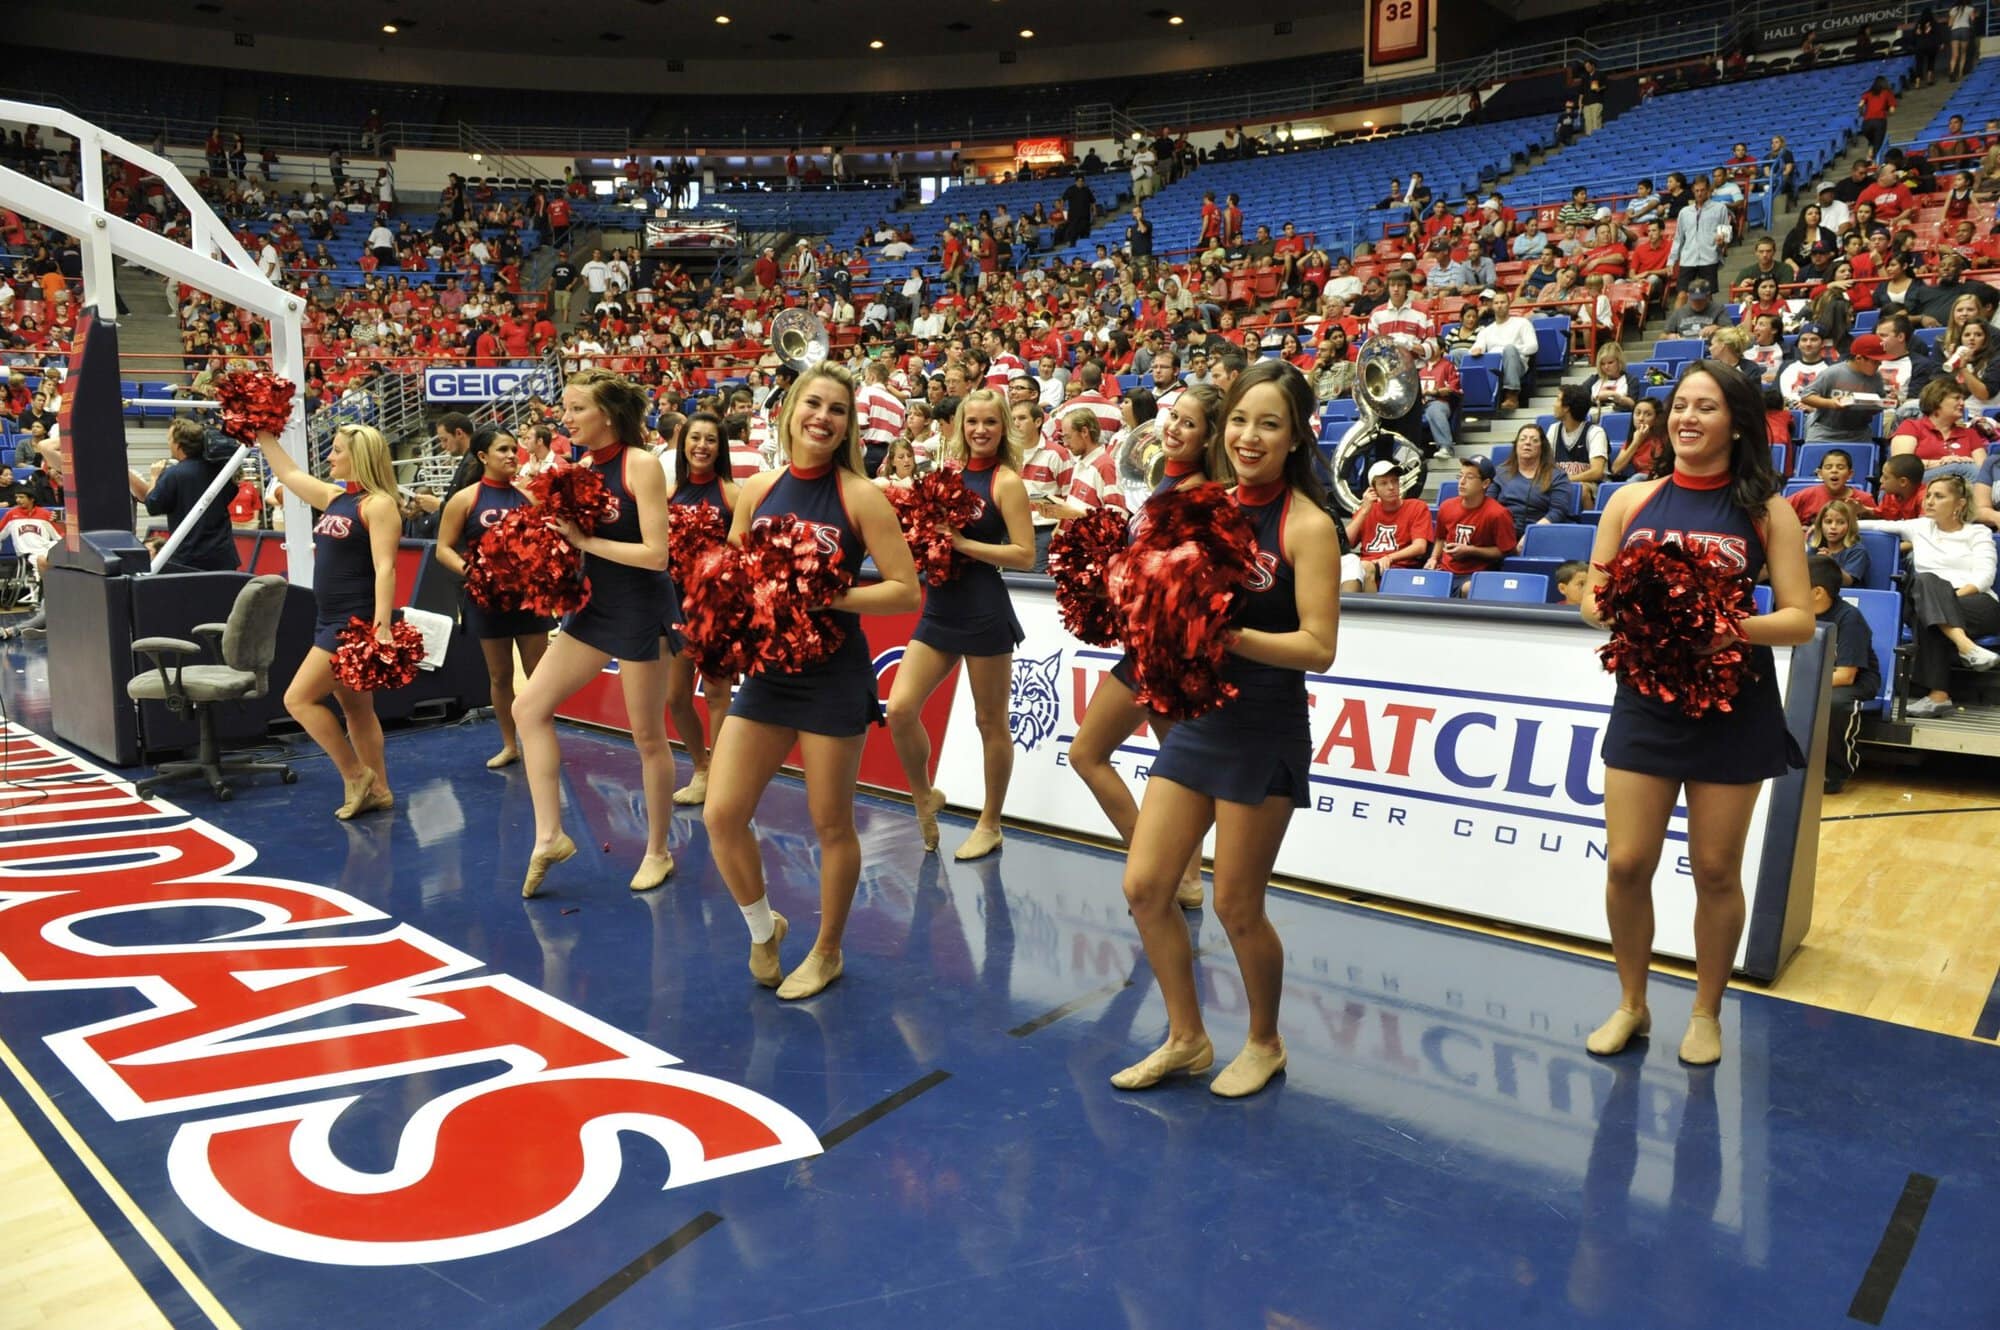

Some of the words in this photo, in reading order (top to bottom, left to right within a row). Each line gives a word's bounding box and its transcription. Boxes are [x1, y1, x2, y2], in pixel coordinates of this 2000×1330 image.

[1386, 1, 1412, 21] 32
[1764, 27, 1797, 40] HALL
[1801, 21, 1817, 34] OF
[1822, 7, 1903, 30] CHAMPIONS
[1541, 209, 1555, 221] 21
[428, 373, 551, 397] GEICO
[1366, 523, 1399, 552] A
